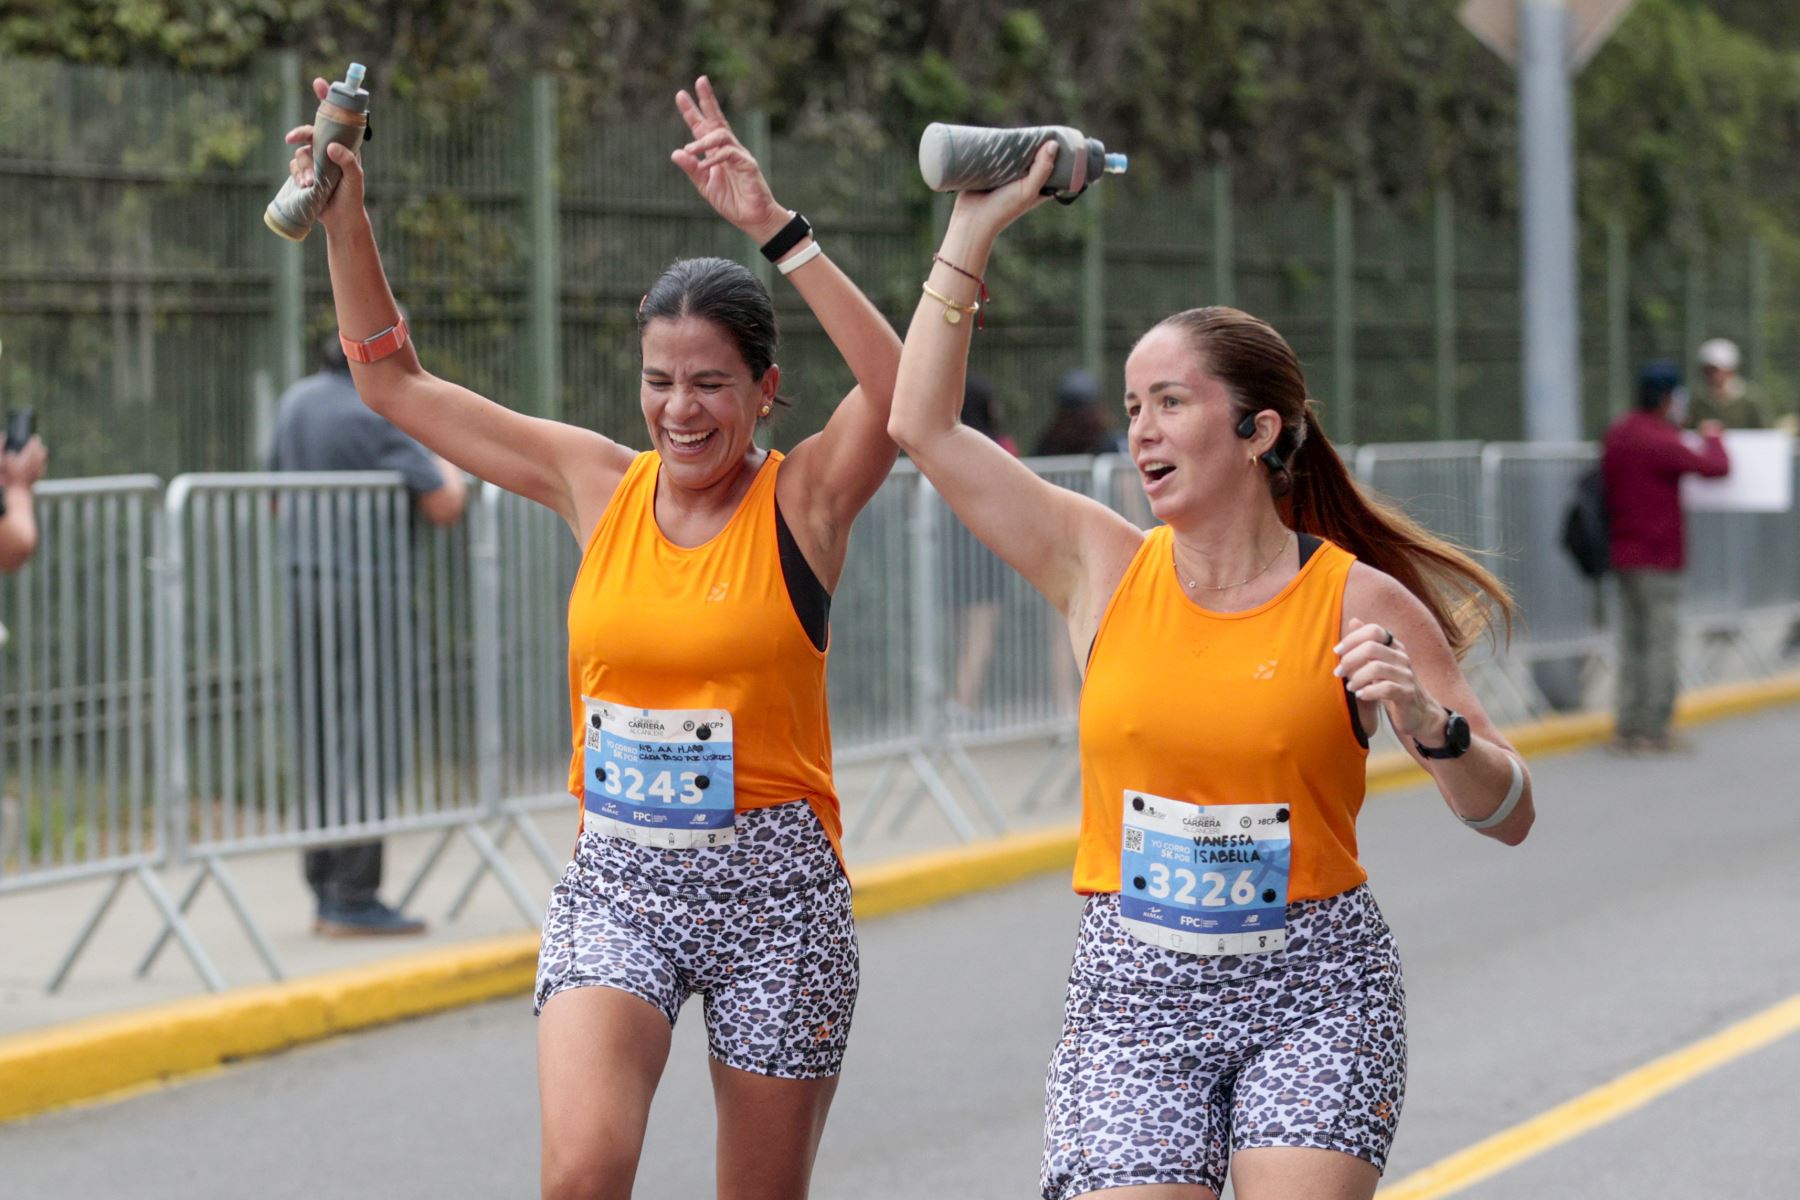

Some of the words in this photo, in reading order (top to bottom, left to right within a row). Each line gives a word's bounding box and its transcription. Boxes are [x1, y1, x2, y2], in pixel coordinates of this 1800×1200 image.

[628, 721, 665, 730] CARRERA
[604, 760, 704, 805] 3243
[633, 811, 652, 822] FPC
[1182, 818, 1221, 828] CARRERA
[1151, 840, 1162, 848] YO
[1163, 842, 1191, 854] CORRO
[1193, 834, 1255, 848] VANESSA
[1161, 848, 1173, 860] 5K
[1174, 853, 1191, 863] POR
[1194, 849, 1261, 864] ISABELLA
[1148, 862, 1256, 907] 3226
[1180, 915, 1200, 928] FPC
